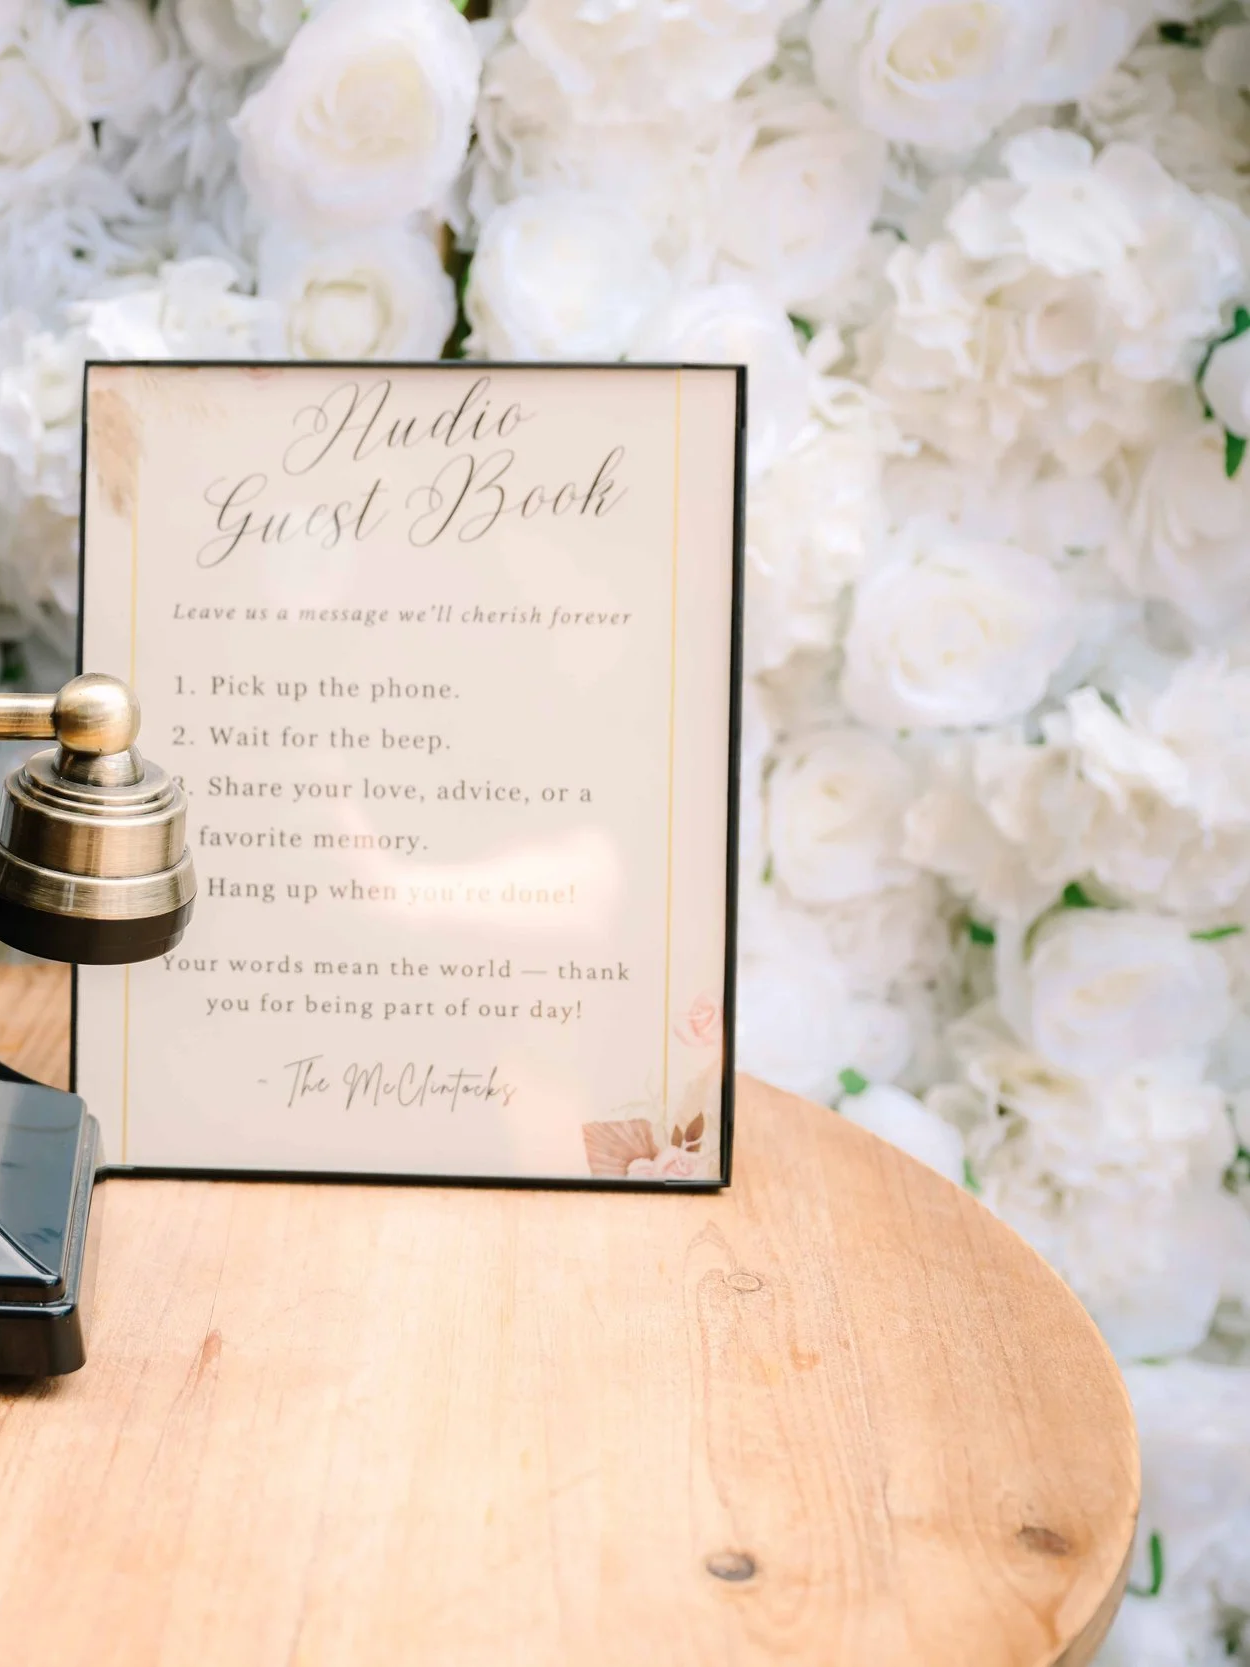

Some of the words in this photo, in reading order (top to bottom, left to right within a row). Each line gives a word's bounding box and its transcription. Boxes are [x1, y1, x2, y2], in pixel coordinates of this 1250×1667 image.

[282, 376, 536, 475] Audio
[196, 472, 388, 568] Guest
[405, 446, 628, 547] Book
[172, 602, 237, 621] Leave
[245, 607, 268, 622] us
[275, 607, 289, 621] a
[298, 608, 389, 629] message
[398, 603, 453, 624] we'll
[460, 604, 542, 625] cherish
[547, 605, 633, 630] forever
[175, 674, 196, 696] 1.
[211, 674, 265, 697] Pick
[276, 681, 308, 703] up
[318, 675, 360, 698] the
[370, 676, 460, 704] phone.
[171, 724, 195, 747] 2.
[209, 725, 269, 748] Wait
[281, 725, 319, 748] for
[329, 727, 371, 749] the
[381, 727, 451, 756] beep.
[207, 775, 283, 798] Share
[292, 782, 353, 804] your
[363, 777, 426, 804] love,
[436, 778, 530, 805] advice,
[541, 787, 570, 803] or
[579, 787, 592, 803] a
[199, 824, 303, 848] favorite
[313, 833, 429, 856] memory.
[207, 876, 276, 903] Hang
[286, 883, 319, 905] up
[328, 878, 396, 901] when
[501, 883, 575, 904] done!
[161, 953, 219, 972] Your
[228, 954, 304, 975] words
[313, 961, 379, 976] mean
[390, 956, 430, 977] the
[439, 958, 511, 979] world
[557, 960, 630, 981] thank
[205, 997, 250, 1017] you
[259, 992, 295, 1013] for
[304, 993, 374, 1020] being
[383, 1001, 435, 1021] part
[444, 997, 471, 1017] of
[477, 1004, 520, 1018] our
[529, 999, 582, 1025] day!
[283, 1053, 331, 1109] The
[342, 1061, 517, 1113] McClintocks
